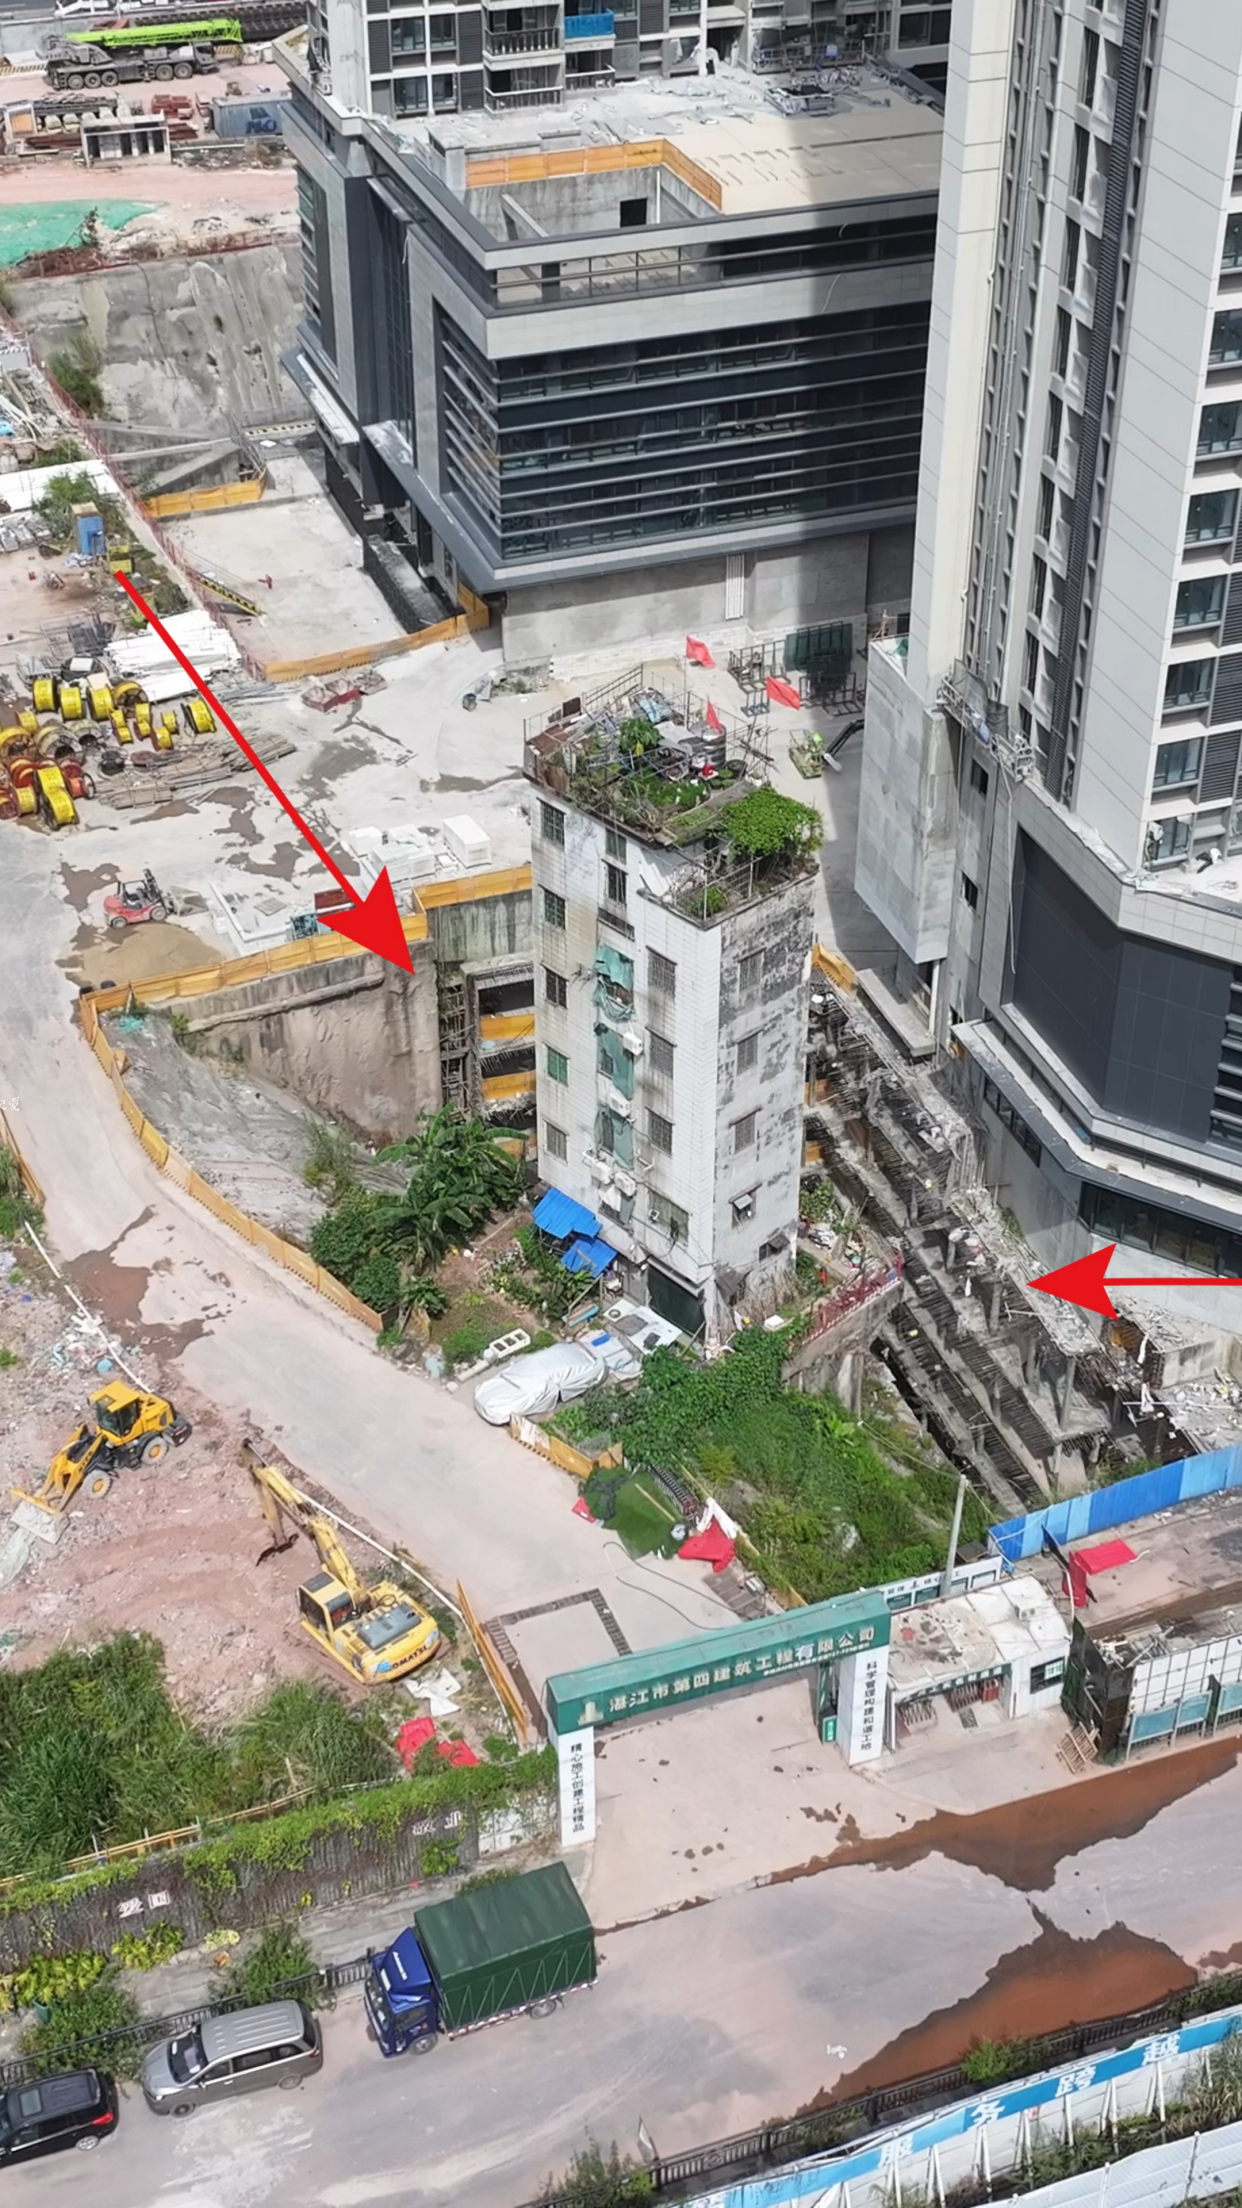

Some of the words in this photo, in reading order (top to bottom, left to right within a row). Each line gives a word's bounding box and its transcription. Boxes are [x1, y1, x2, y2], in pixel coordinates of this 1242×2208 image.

[609, 1626, 875, 1712] 湛江市第四建筑工程有限公司
[860, 1660, 878, 1751] 科学管理构建和谐工地
[570, 1742, 585, 1833] 精心施工创建工程精品
